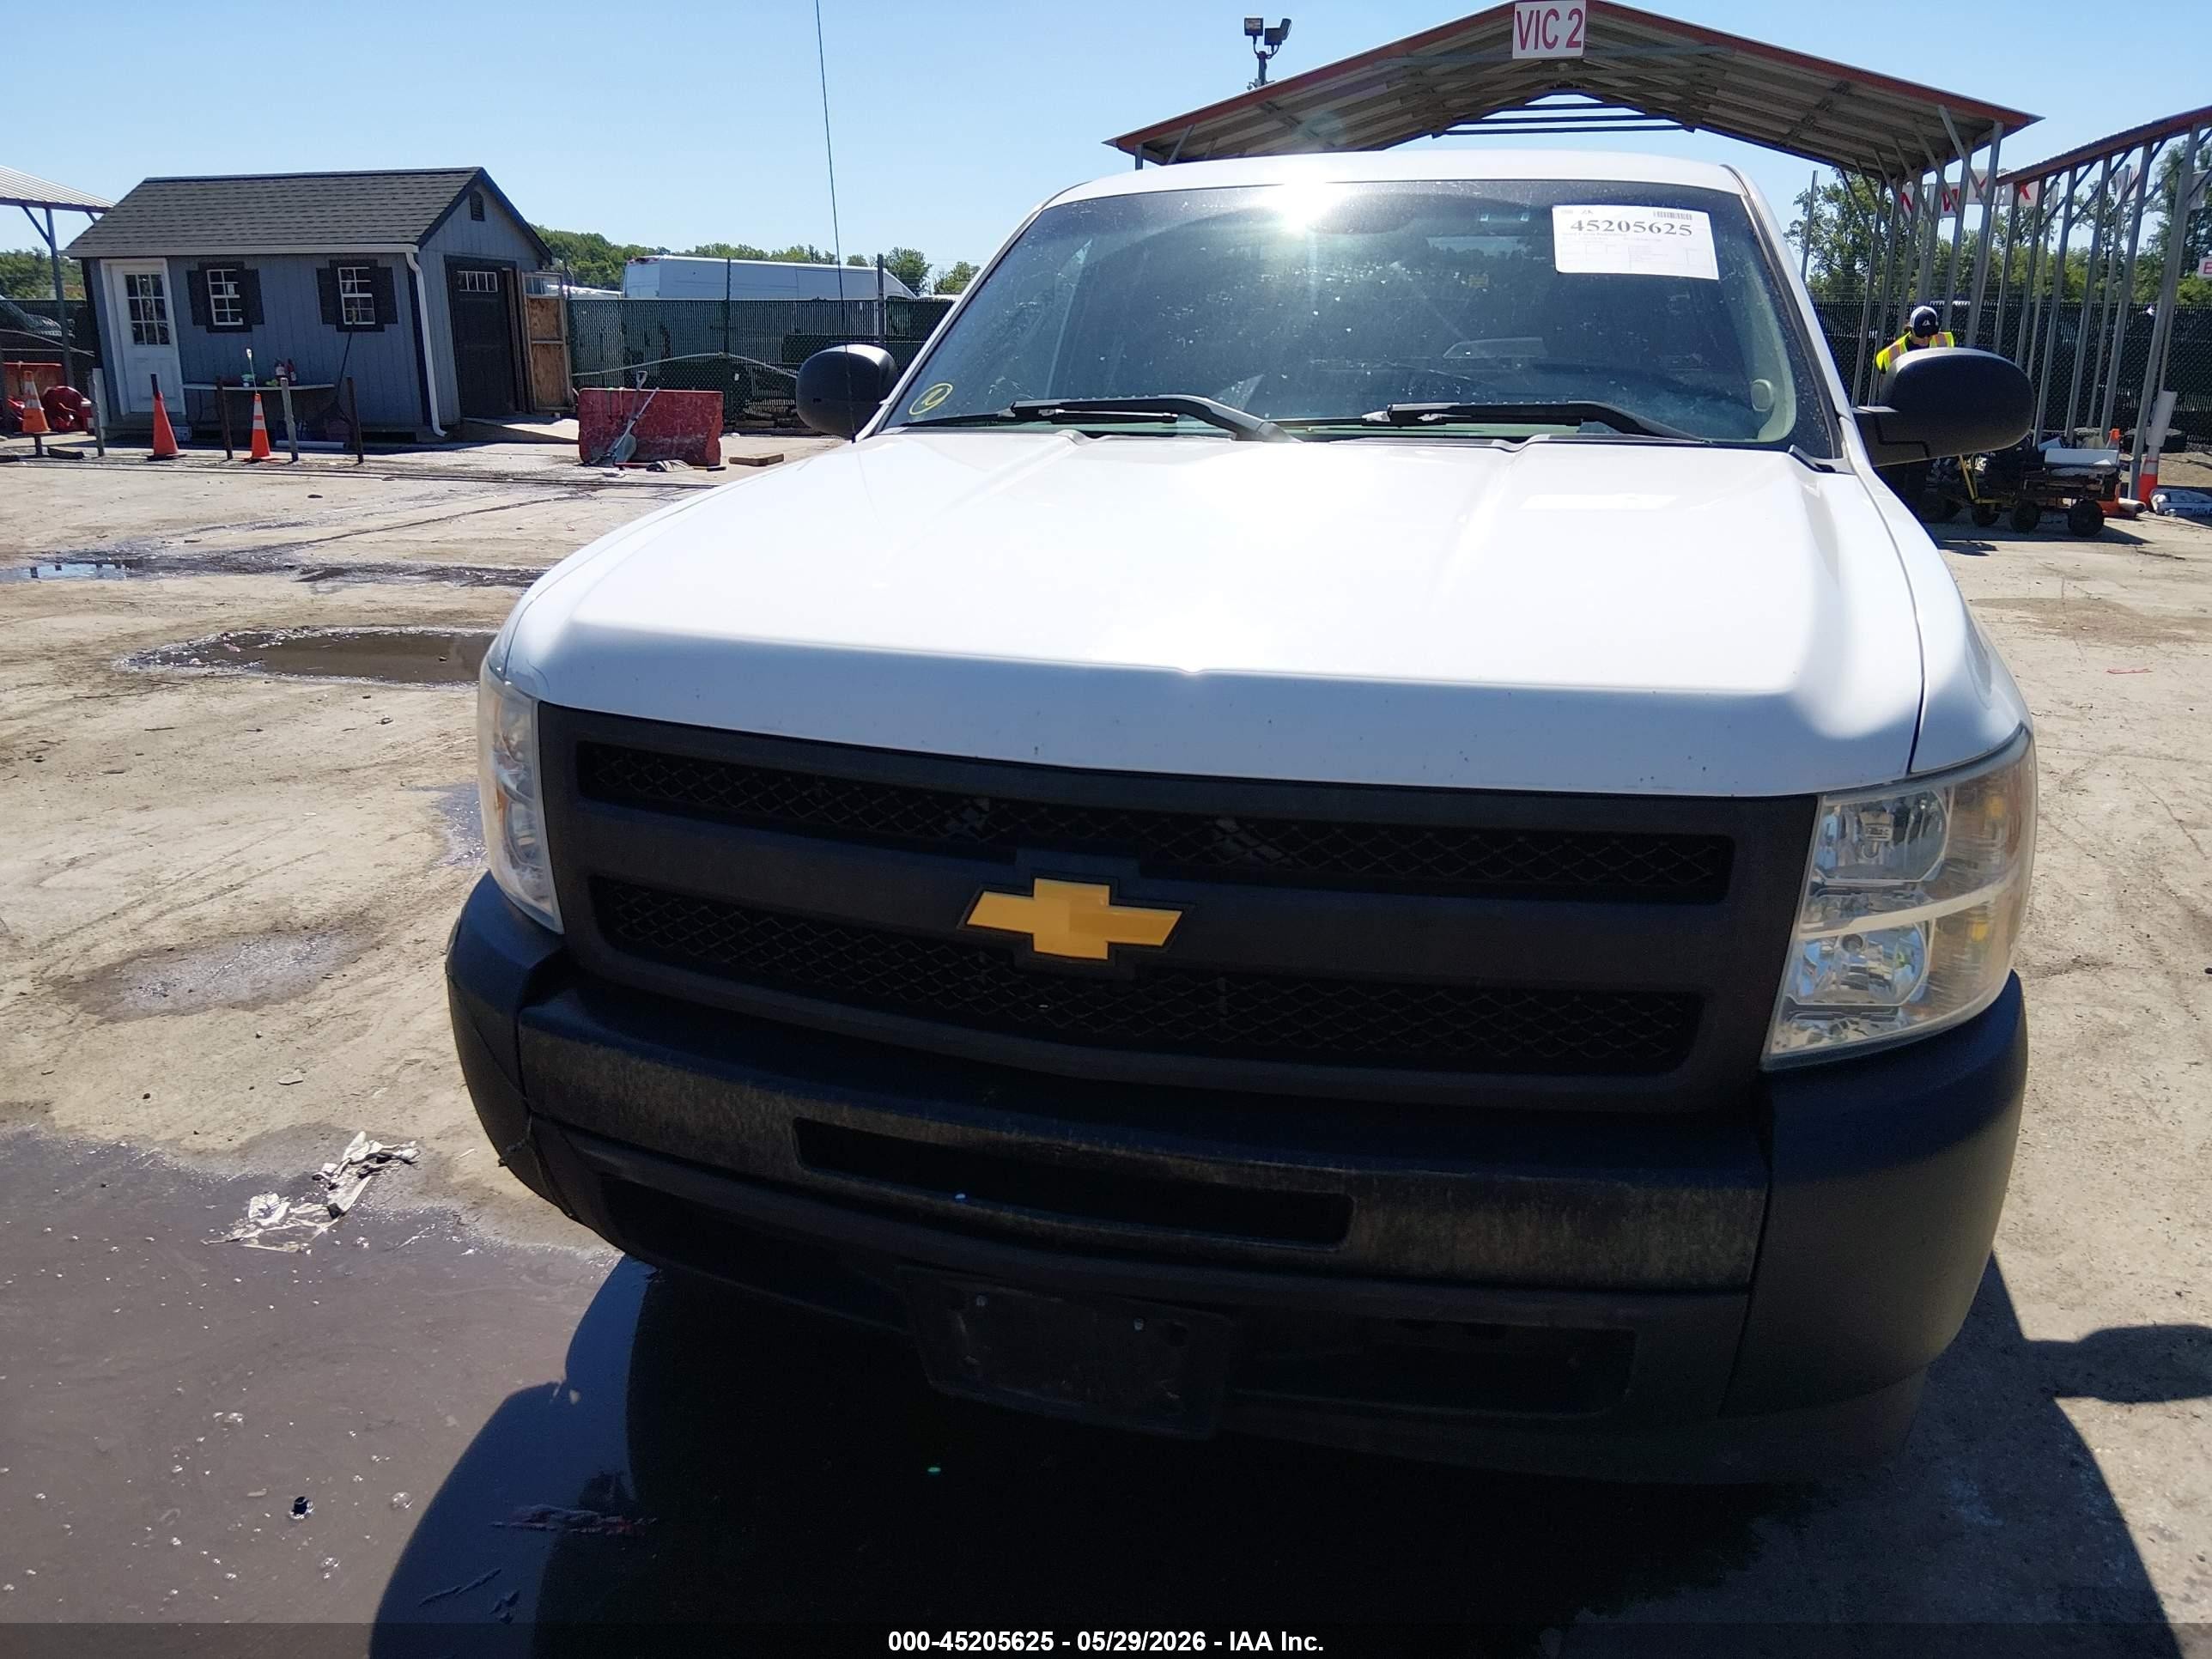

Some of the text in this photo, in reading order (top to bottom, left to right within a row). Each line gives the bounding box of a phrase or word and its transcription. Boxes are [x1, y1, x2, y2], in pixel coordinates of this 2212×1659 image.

[1516, 8, 1583, 50] VIC 2
[1570, 219, 1692, 237] 45205625
